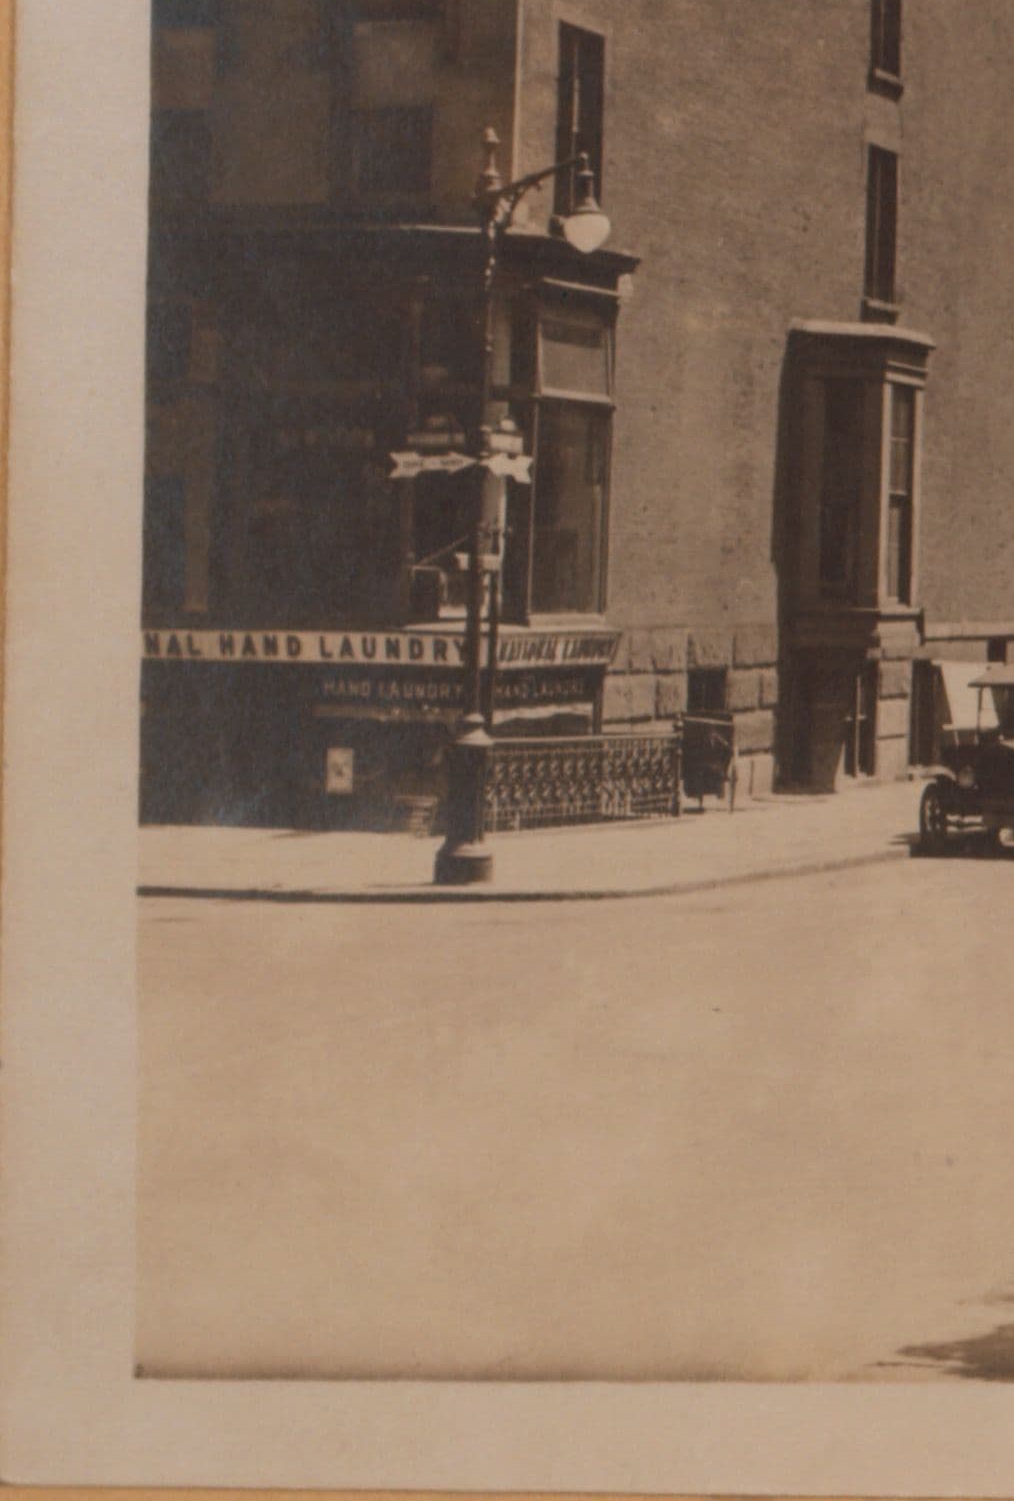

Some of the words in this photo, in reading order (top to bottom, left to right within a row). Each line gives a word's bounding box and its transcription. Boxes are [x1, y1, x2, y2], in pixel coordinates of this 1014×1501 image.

[219, 634, 303, 658] HAND
[318, 635, 467, 662] LAUNDRY
[324, 681, 371, 697] HAND
